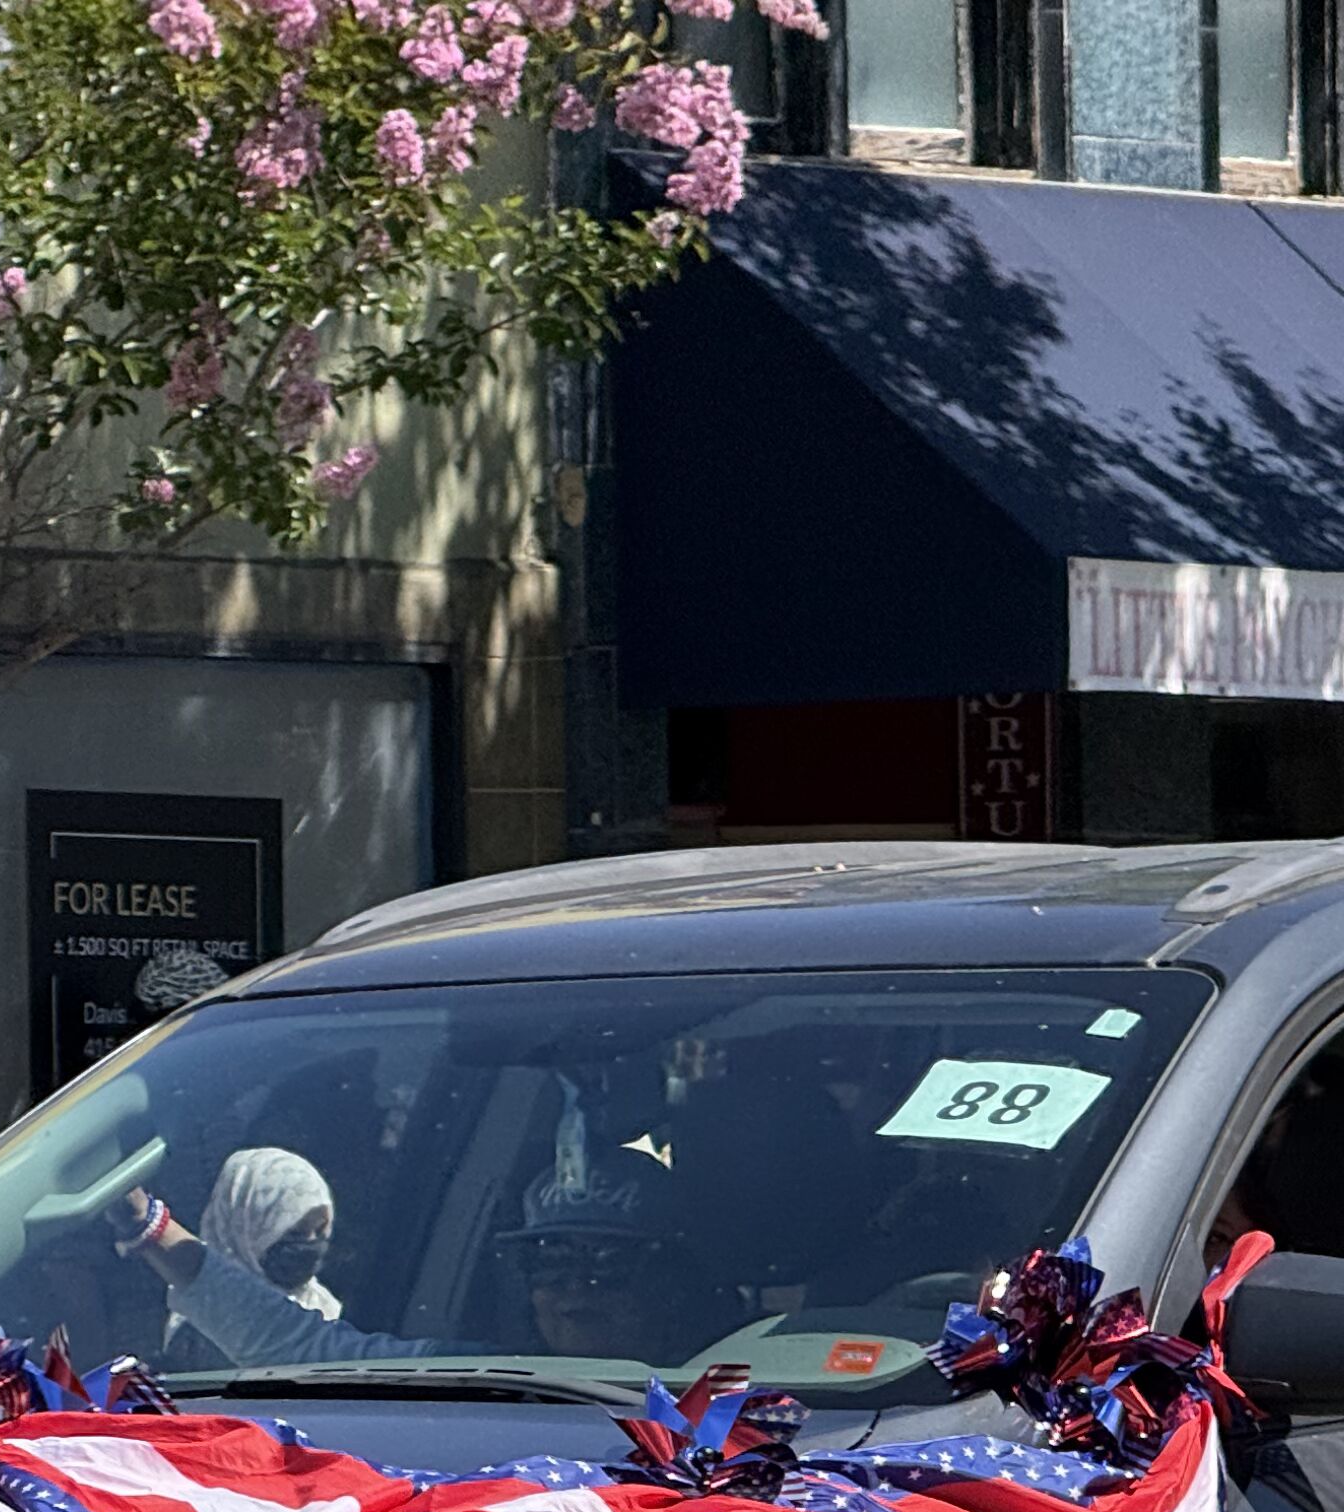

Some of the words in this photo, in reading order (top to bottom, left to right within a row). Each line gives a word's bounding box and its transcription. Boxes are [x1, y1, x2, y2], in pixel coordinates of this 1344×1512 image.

[53, 882, 110, 915] FOR
[116, 883, 197, 918] LEASE
[108, 937, 130, 959] SQ
[131, 938, 152, 957] FT
[202, 940, 250, 960] SPACE
[83, 1001, 127, 1025] Davis
[936, 1080, 1051, 1126] 88
